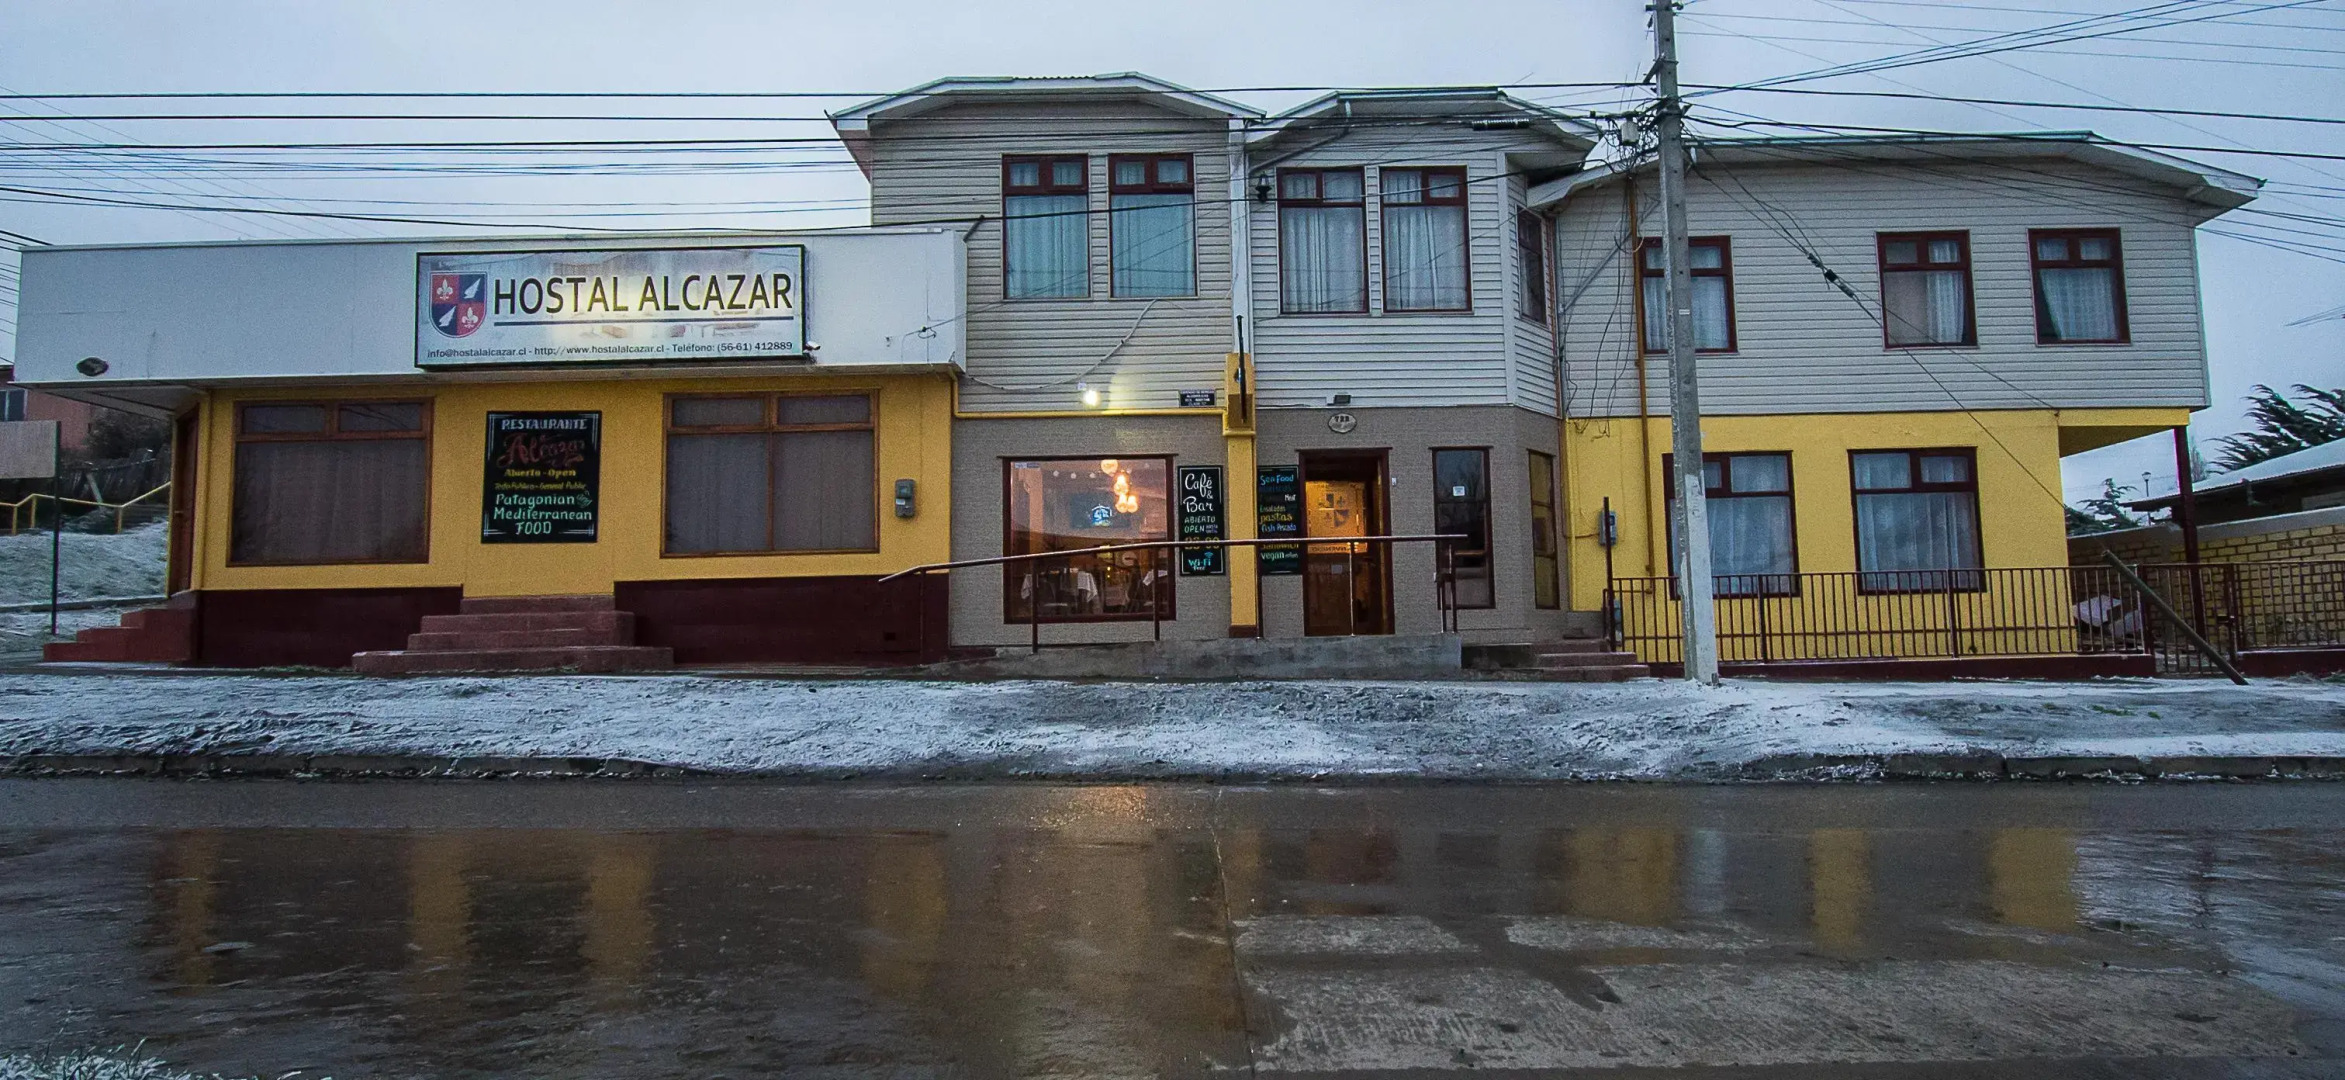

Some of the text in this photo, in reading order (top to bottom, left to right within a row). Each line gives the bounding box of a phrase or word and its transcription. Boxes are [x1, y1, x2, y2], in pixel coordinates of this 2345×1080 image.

[494, 273, 792, 315] HOSTAL ALCAZAR
[427, 347, 527, 358] info@hostalalcazar.cl
[534, 344, 664, 356] http://www.hostalalcazar.cl
[672, 343, 715, 353] Teléfono:
[717, 342, 752, 352] (56-61)
[754, 341, 792, 351] 412889
[501, 418, 588, 430] RESTAURANTE
[548, 468, 577, 479] Open
[1276, 474, 1294, 484] Food
[1184, 472, 1213, 497] Café
[496, 493, 575, 508] Patagonian
[1206, 490, 1213, 499] &
[1182, 495, 1213, 512] Bar
[493, 507, 592, 520] Mediterranean
[1259, 512, 1293, 524] pastas
[515, 521, 552, 535] FOOD
[1184, 525, 1205, 533] OPEN
